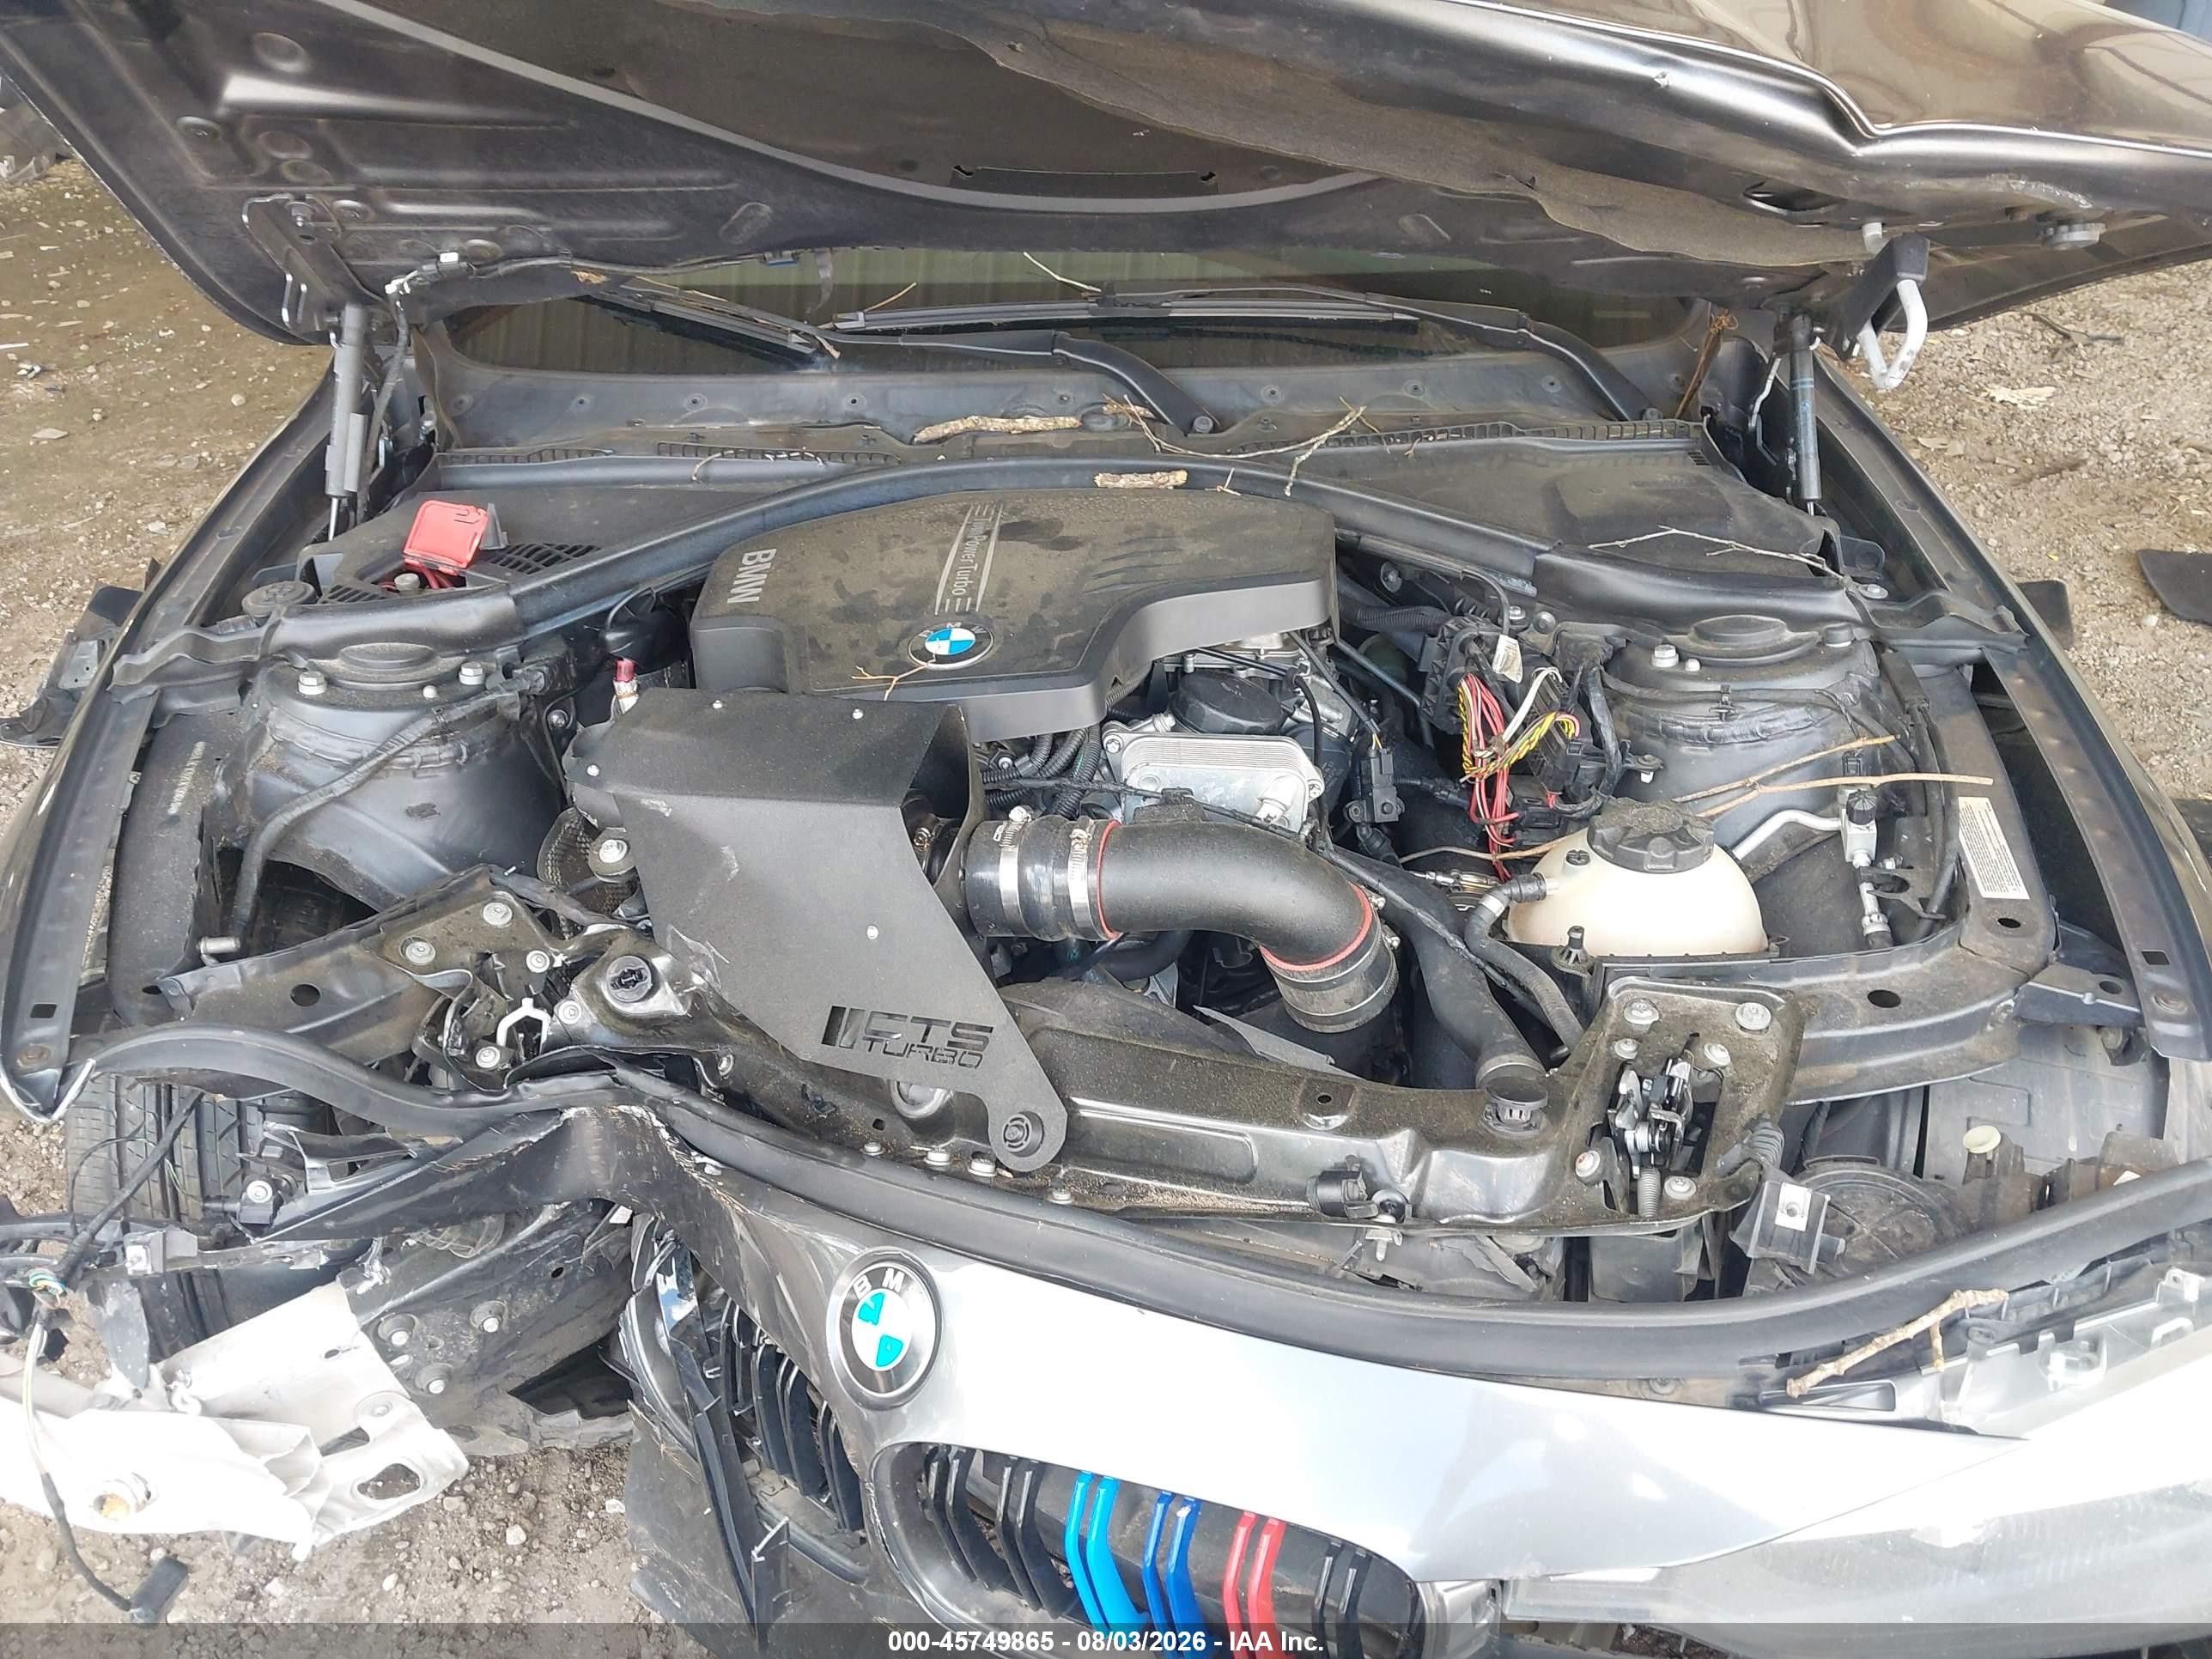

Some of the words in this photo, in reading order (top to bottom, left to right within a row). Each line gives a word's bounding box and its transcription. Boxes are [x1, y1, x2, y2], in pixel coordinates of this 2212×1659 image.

[727, 549, 776, 603] BMW
[951, 563, 978, 595] Turbo
[864, 1011, 994, 1052] CTS
[862, 1036, 984, 1069] TURBO
